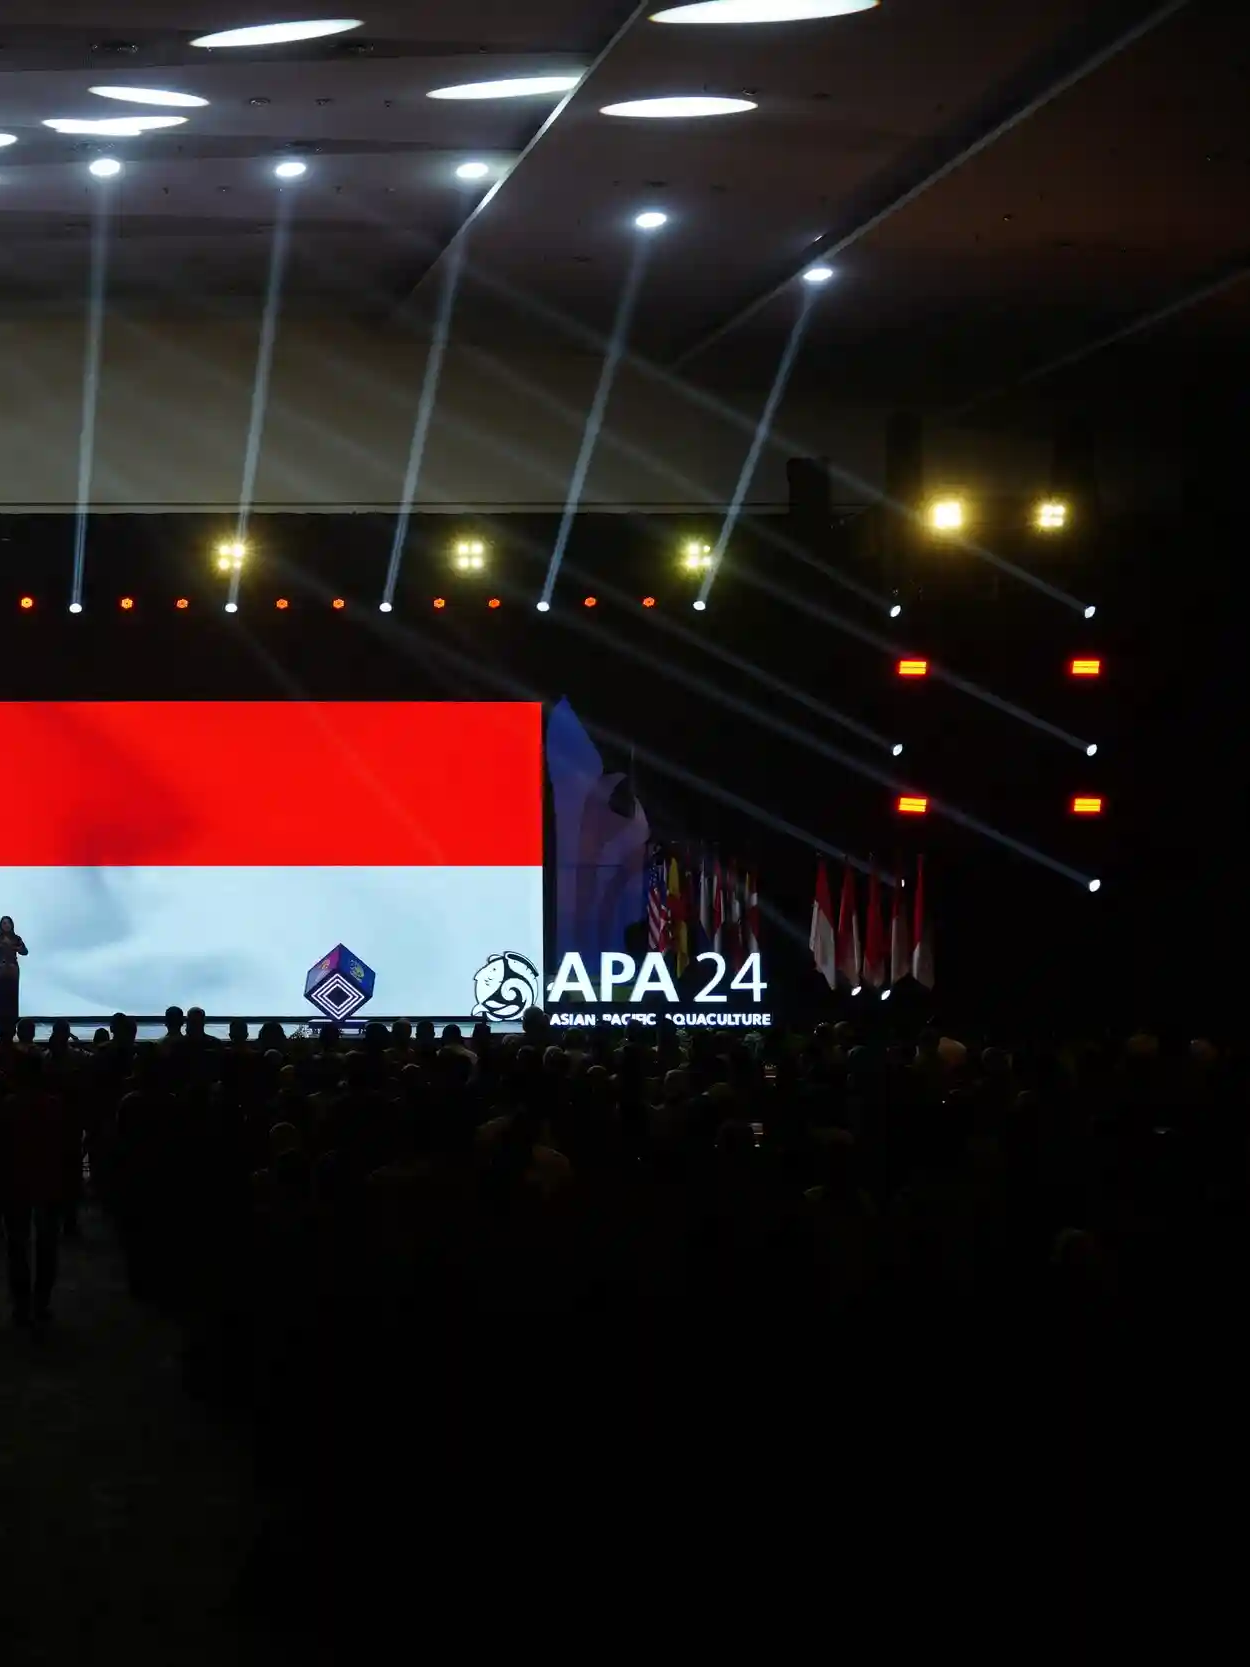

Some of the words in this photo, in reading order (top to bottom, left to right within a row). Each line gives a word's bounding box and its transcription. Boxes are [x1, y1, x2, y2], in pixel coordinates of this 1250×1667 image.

[547, 951, 679, 1002] APA
[693, 951, 768, 1002] 24
[549, 1013, 596, 1026] ASIAN
